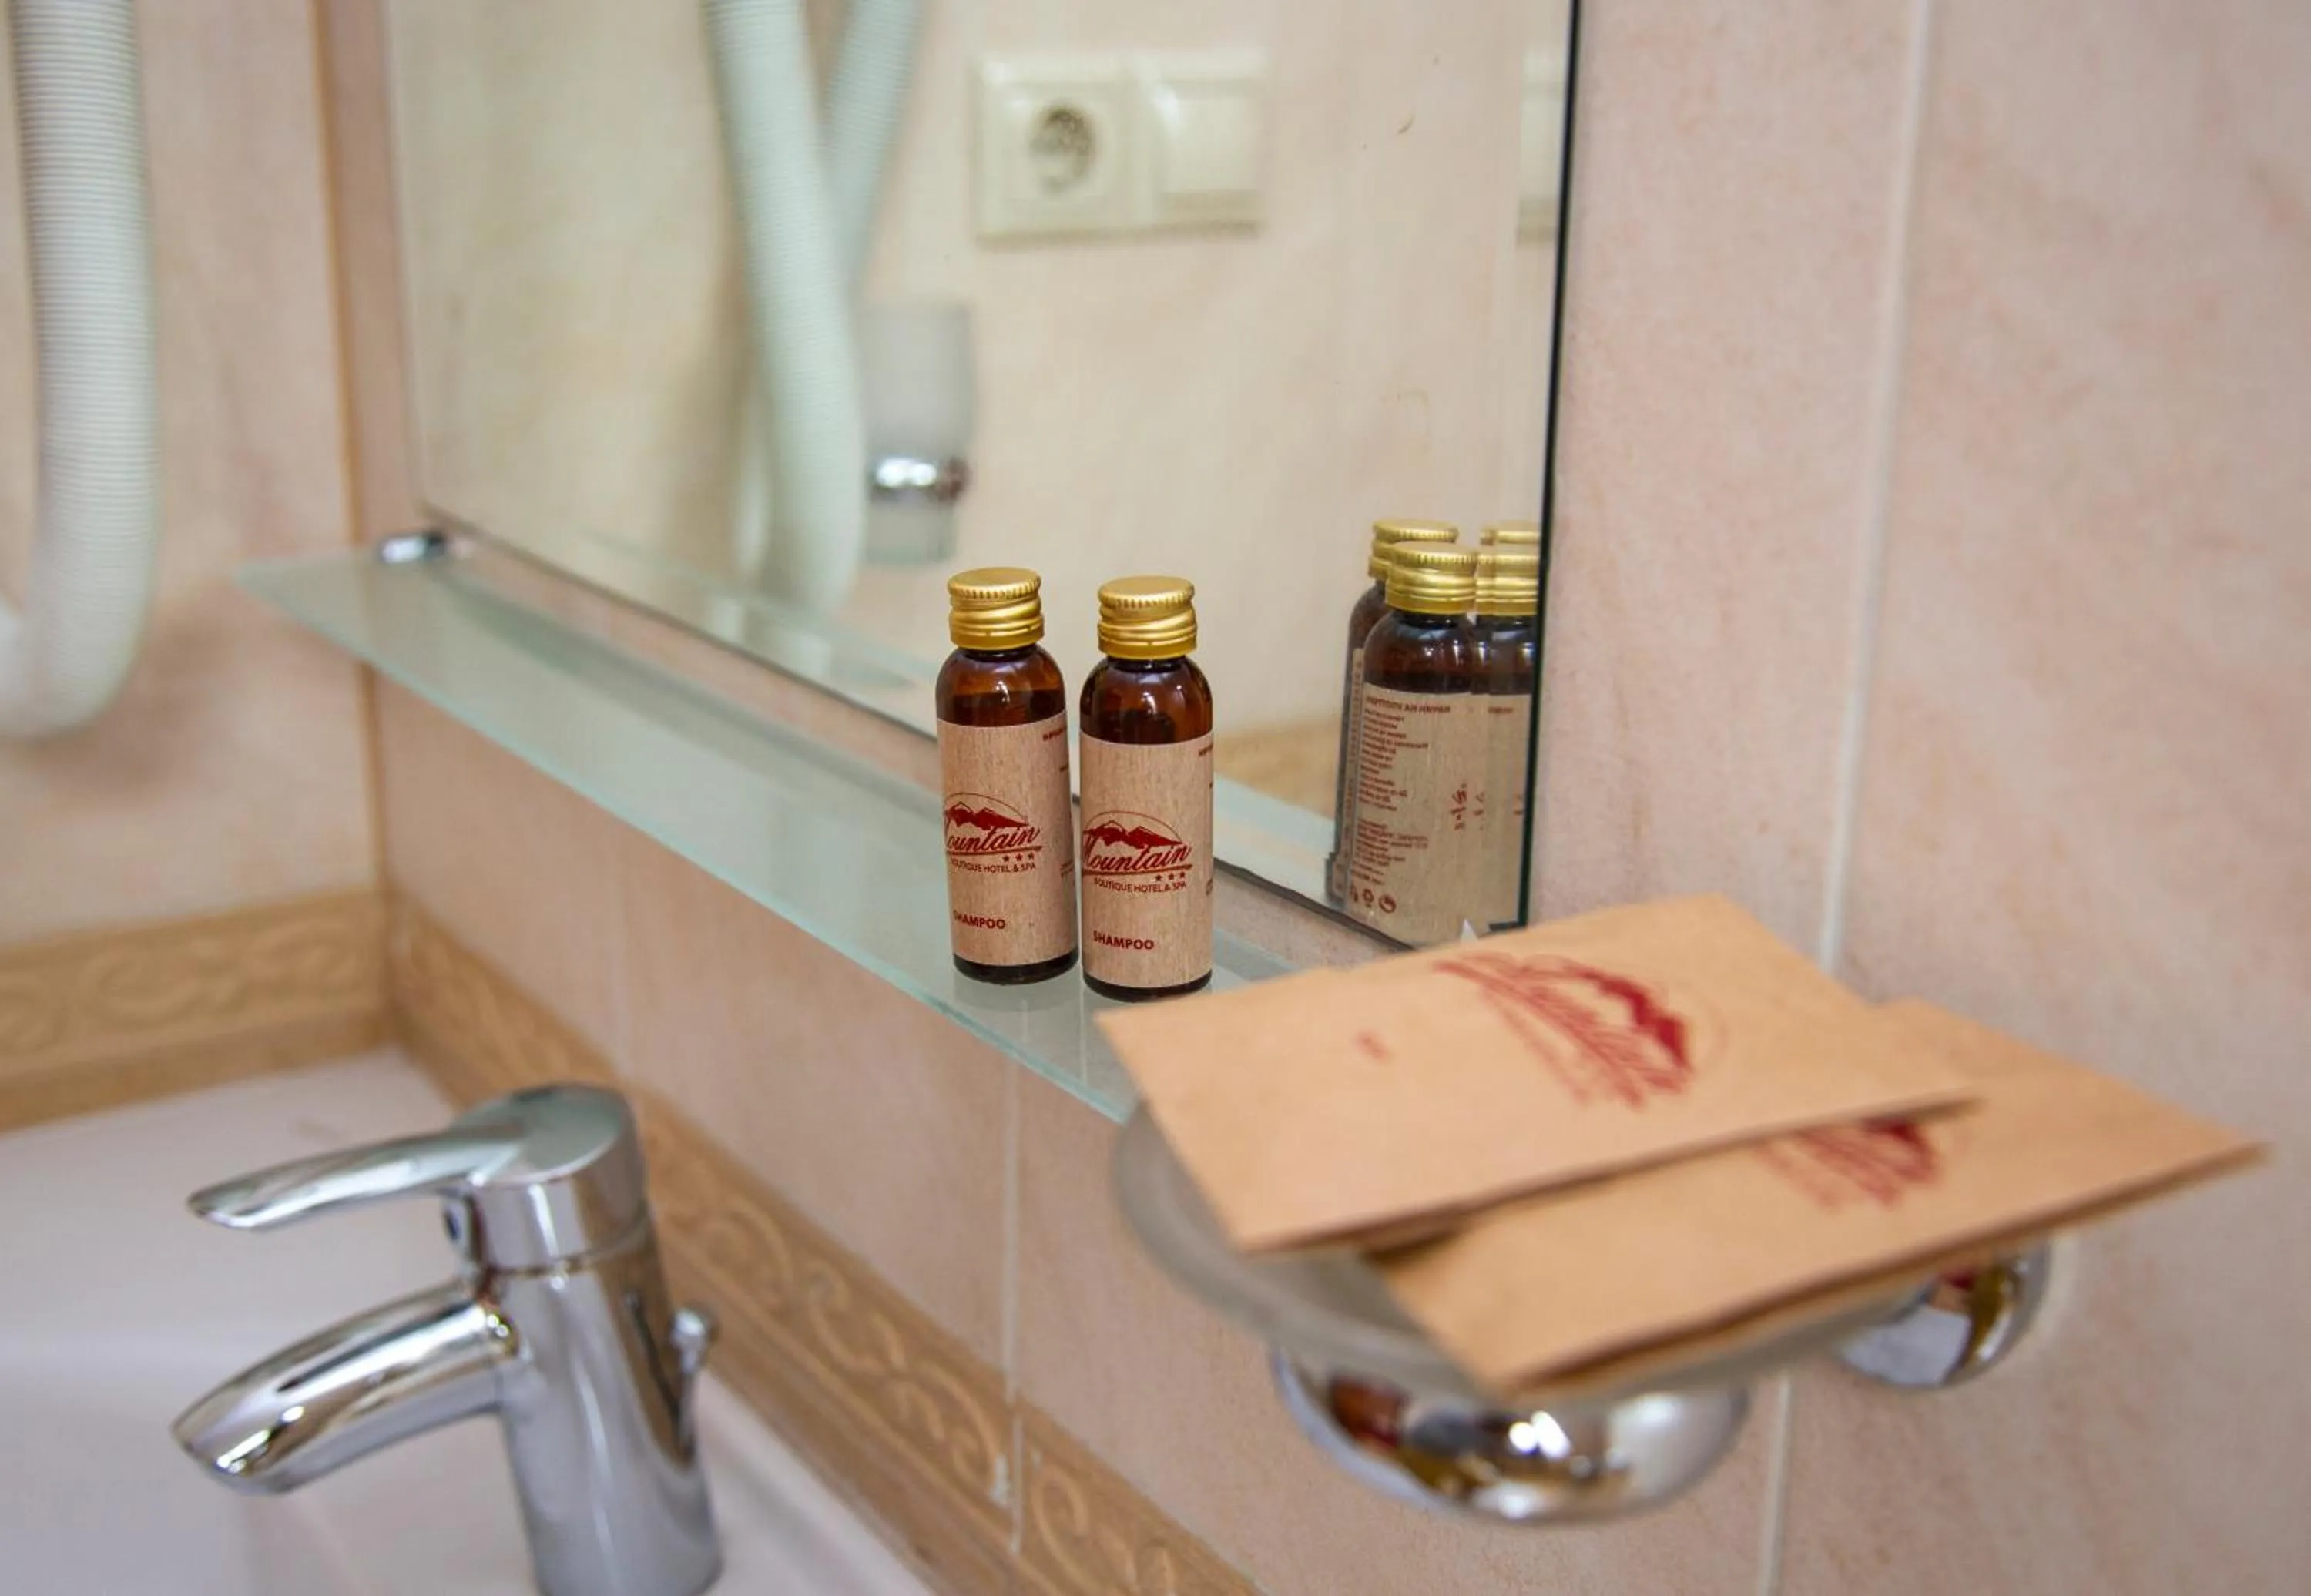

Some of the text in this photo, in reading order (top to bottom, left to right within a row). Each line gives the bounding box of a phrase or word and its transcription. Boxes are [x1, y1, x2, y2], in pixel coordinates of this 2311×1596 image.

[944, 819, 1040, 851] ountain
[984, 864, 1010, 873] HOTEL
[1094, 877, 1132, 893] BOUTIQUE
[1133, 884, 1162, 893] HOTEL
[953, 909, 1005, 930] SHAMPOO
[1093, 930, 1155, 950] SHAMPOO
